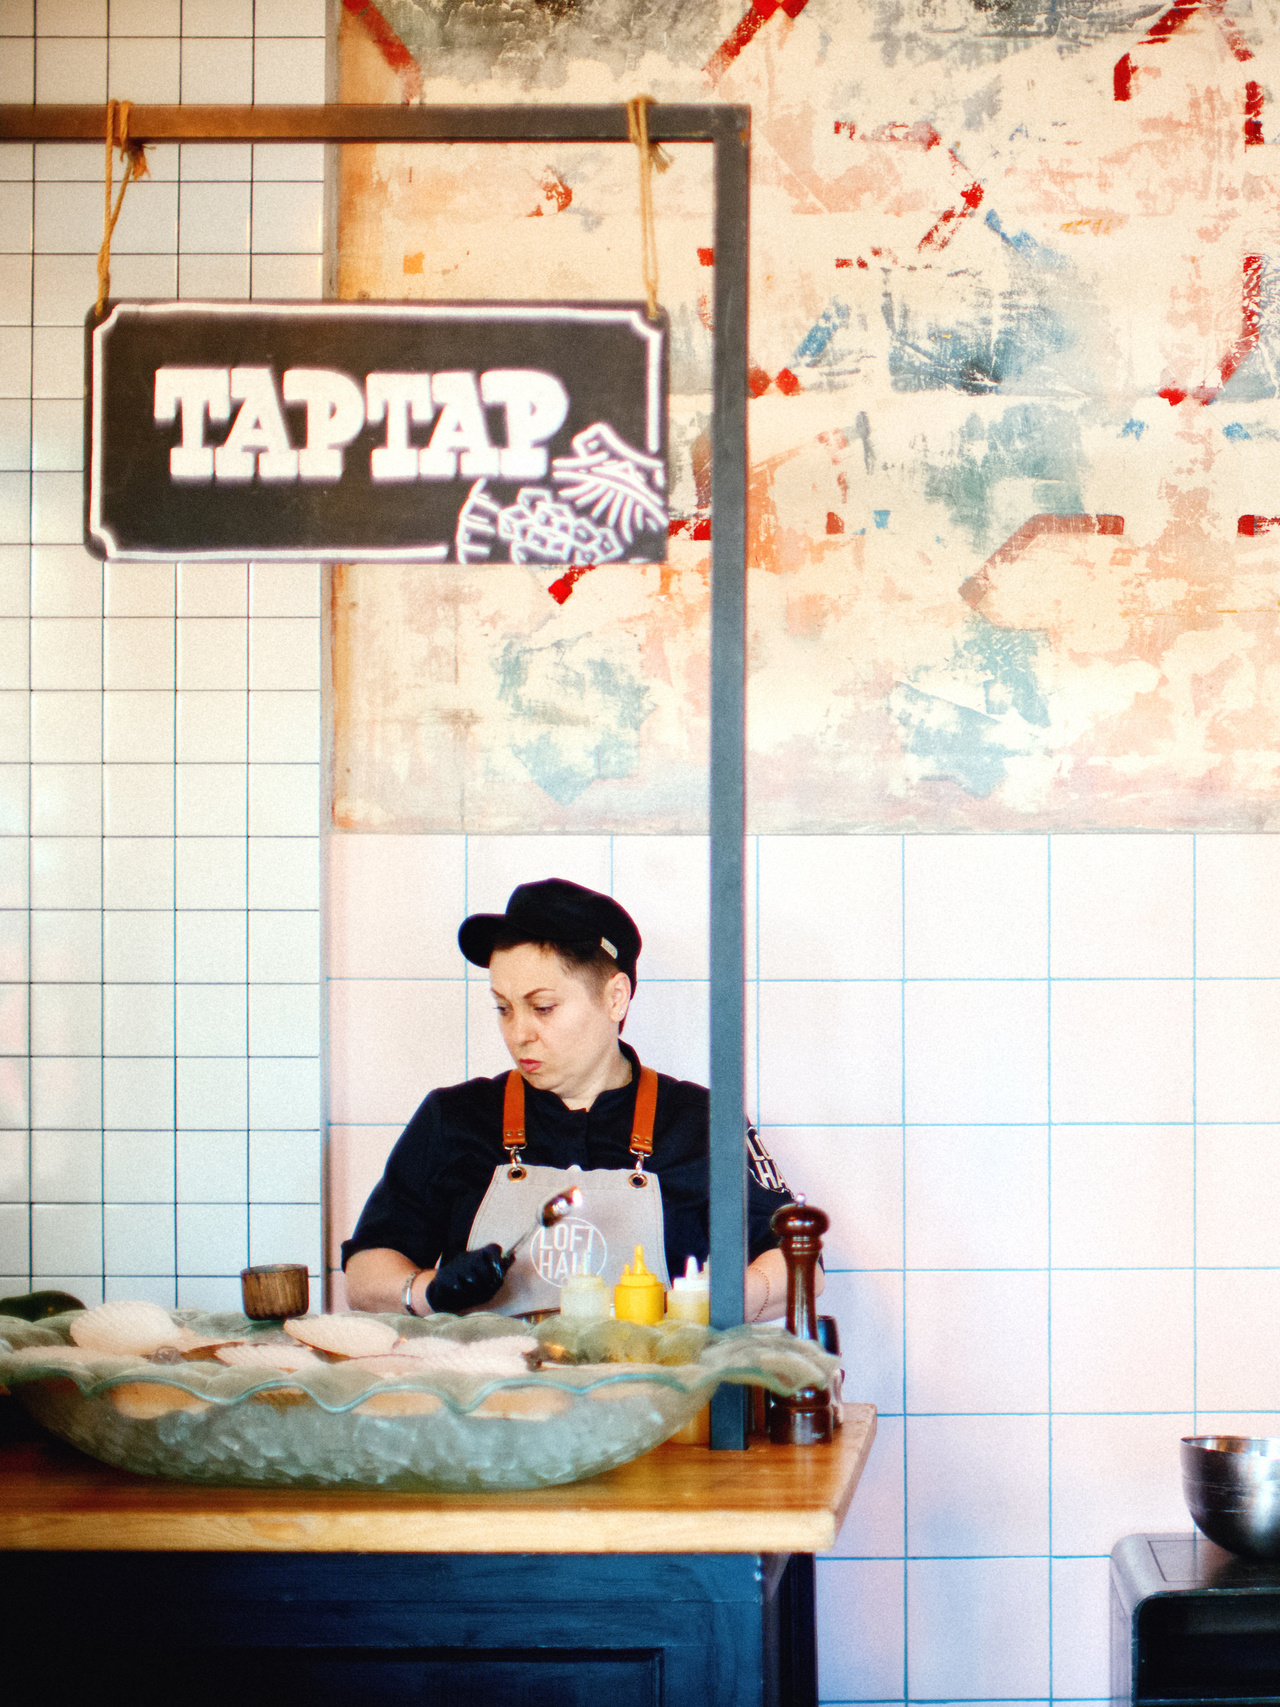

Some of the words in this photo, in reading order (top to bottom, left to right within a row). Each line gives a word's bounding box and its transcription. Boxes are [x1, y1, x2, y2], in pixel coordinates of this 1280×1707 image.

[154, 366, 570, 481] TAPTAP
[746, 1132, 773, 1161] LO
[755, 1159, 788, 1190] HA
[539, 1223, 595, 1252] LOFT
